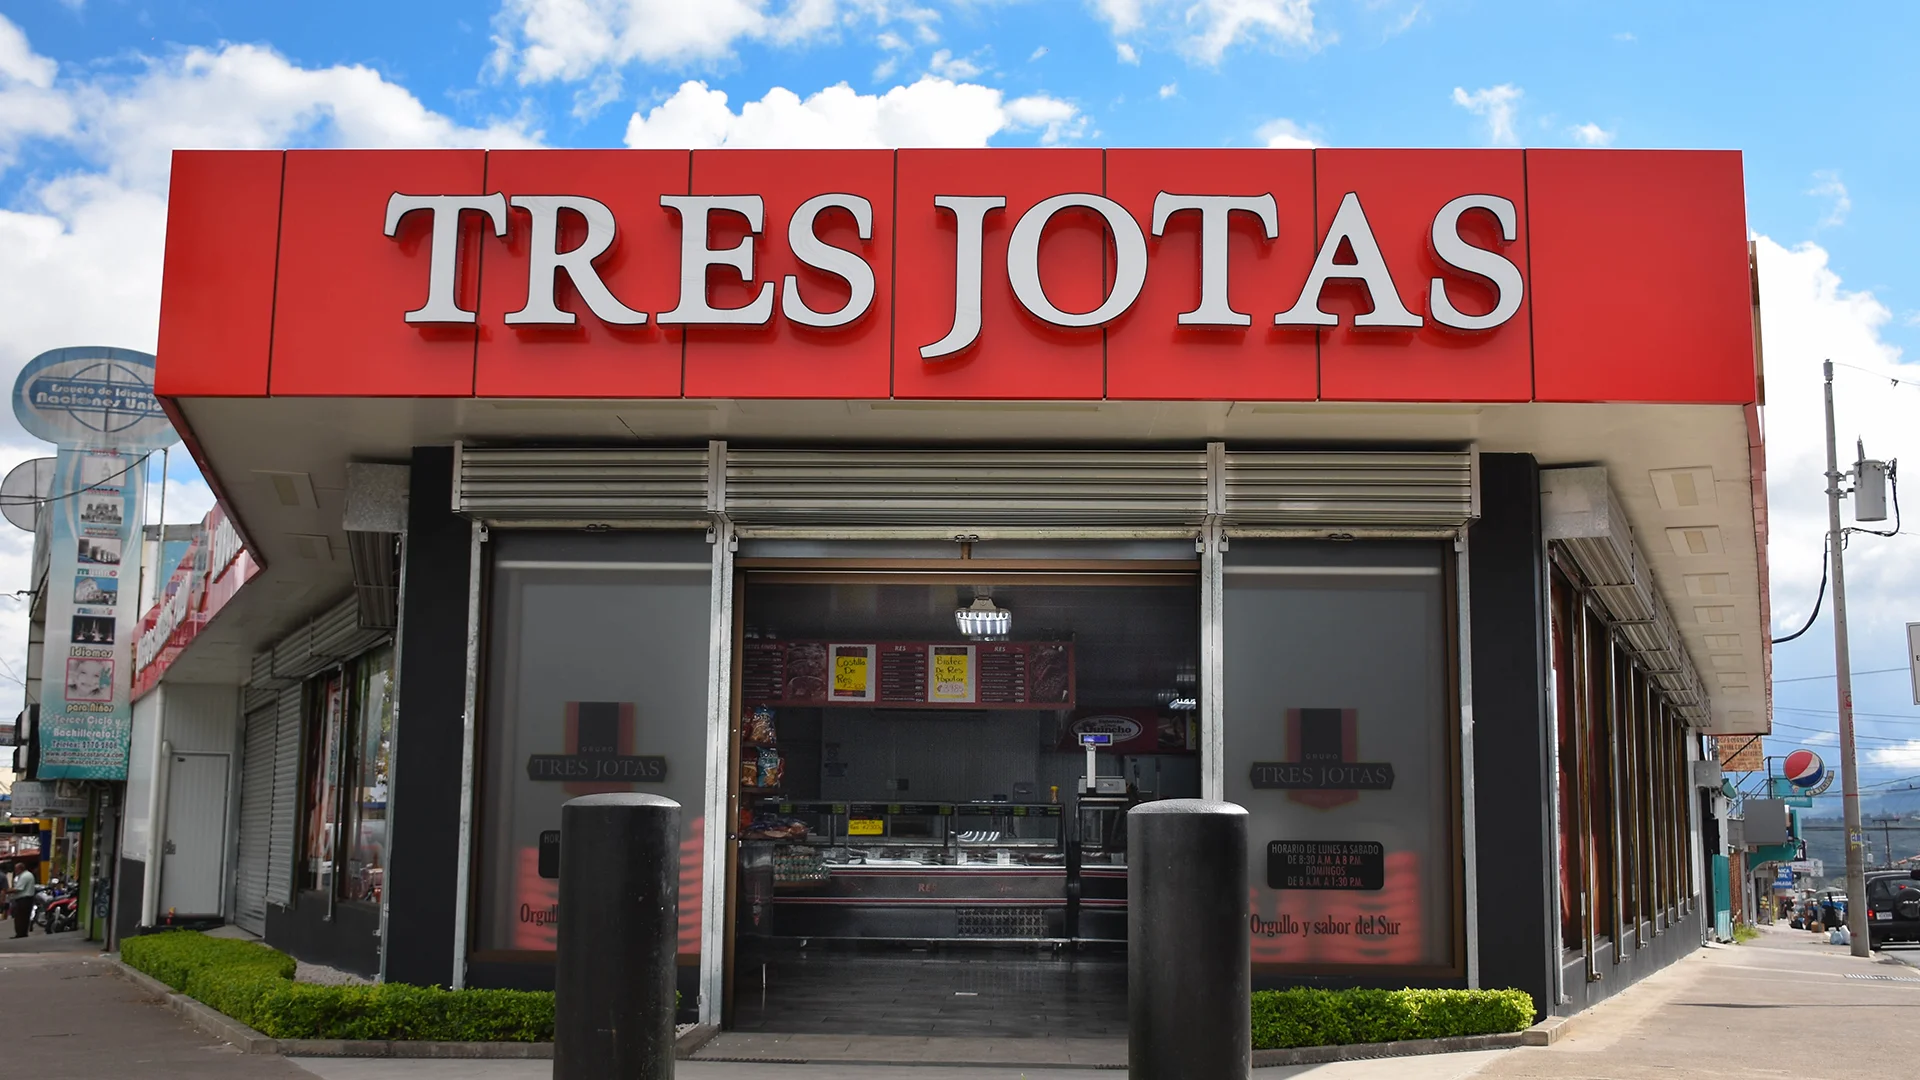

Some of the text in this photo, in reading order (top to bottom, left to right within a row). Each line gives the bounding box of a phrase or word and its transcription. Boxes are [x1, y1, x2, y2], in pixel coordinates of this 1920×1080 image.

[383, 191, 1524, 360] TRES JOTAS
[98, 387, 112, 396] de
[36, 392, 121, 407] Naciones
[70, 646, 113, 658] Idiomas
[836, 656, 866, 667] Costilla
[844, 666, 856, 674] De
[947, 666, 964, 674] Res
[836, 673, 852, 683] Res
[935, 673, 964, 683] Popular
[66, 703, 88, 713] para
[54, 715, 85, 724] Tercer
[87, 715, 113, 725] Ciclo
[534, 758, 660, 778] TRES JOTAS
[1257, 765, 1387, 787] TRES JOTAS
[1271, 844, 1379, 855] HORARIO DE LUNES A SABADO
[1287, 855, 1363, 865] DE 8:30 A.M. A 8 P.M.
[1306, 866, 1346, 876] DOMINGOS
[1287, 876, 1363, 887] DE 8 A.M. A 1:30 P.M.
[1250, 914, 1401, 937] Orgullo y sabor del Sur
